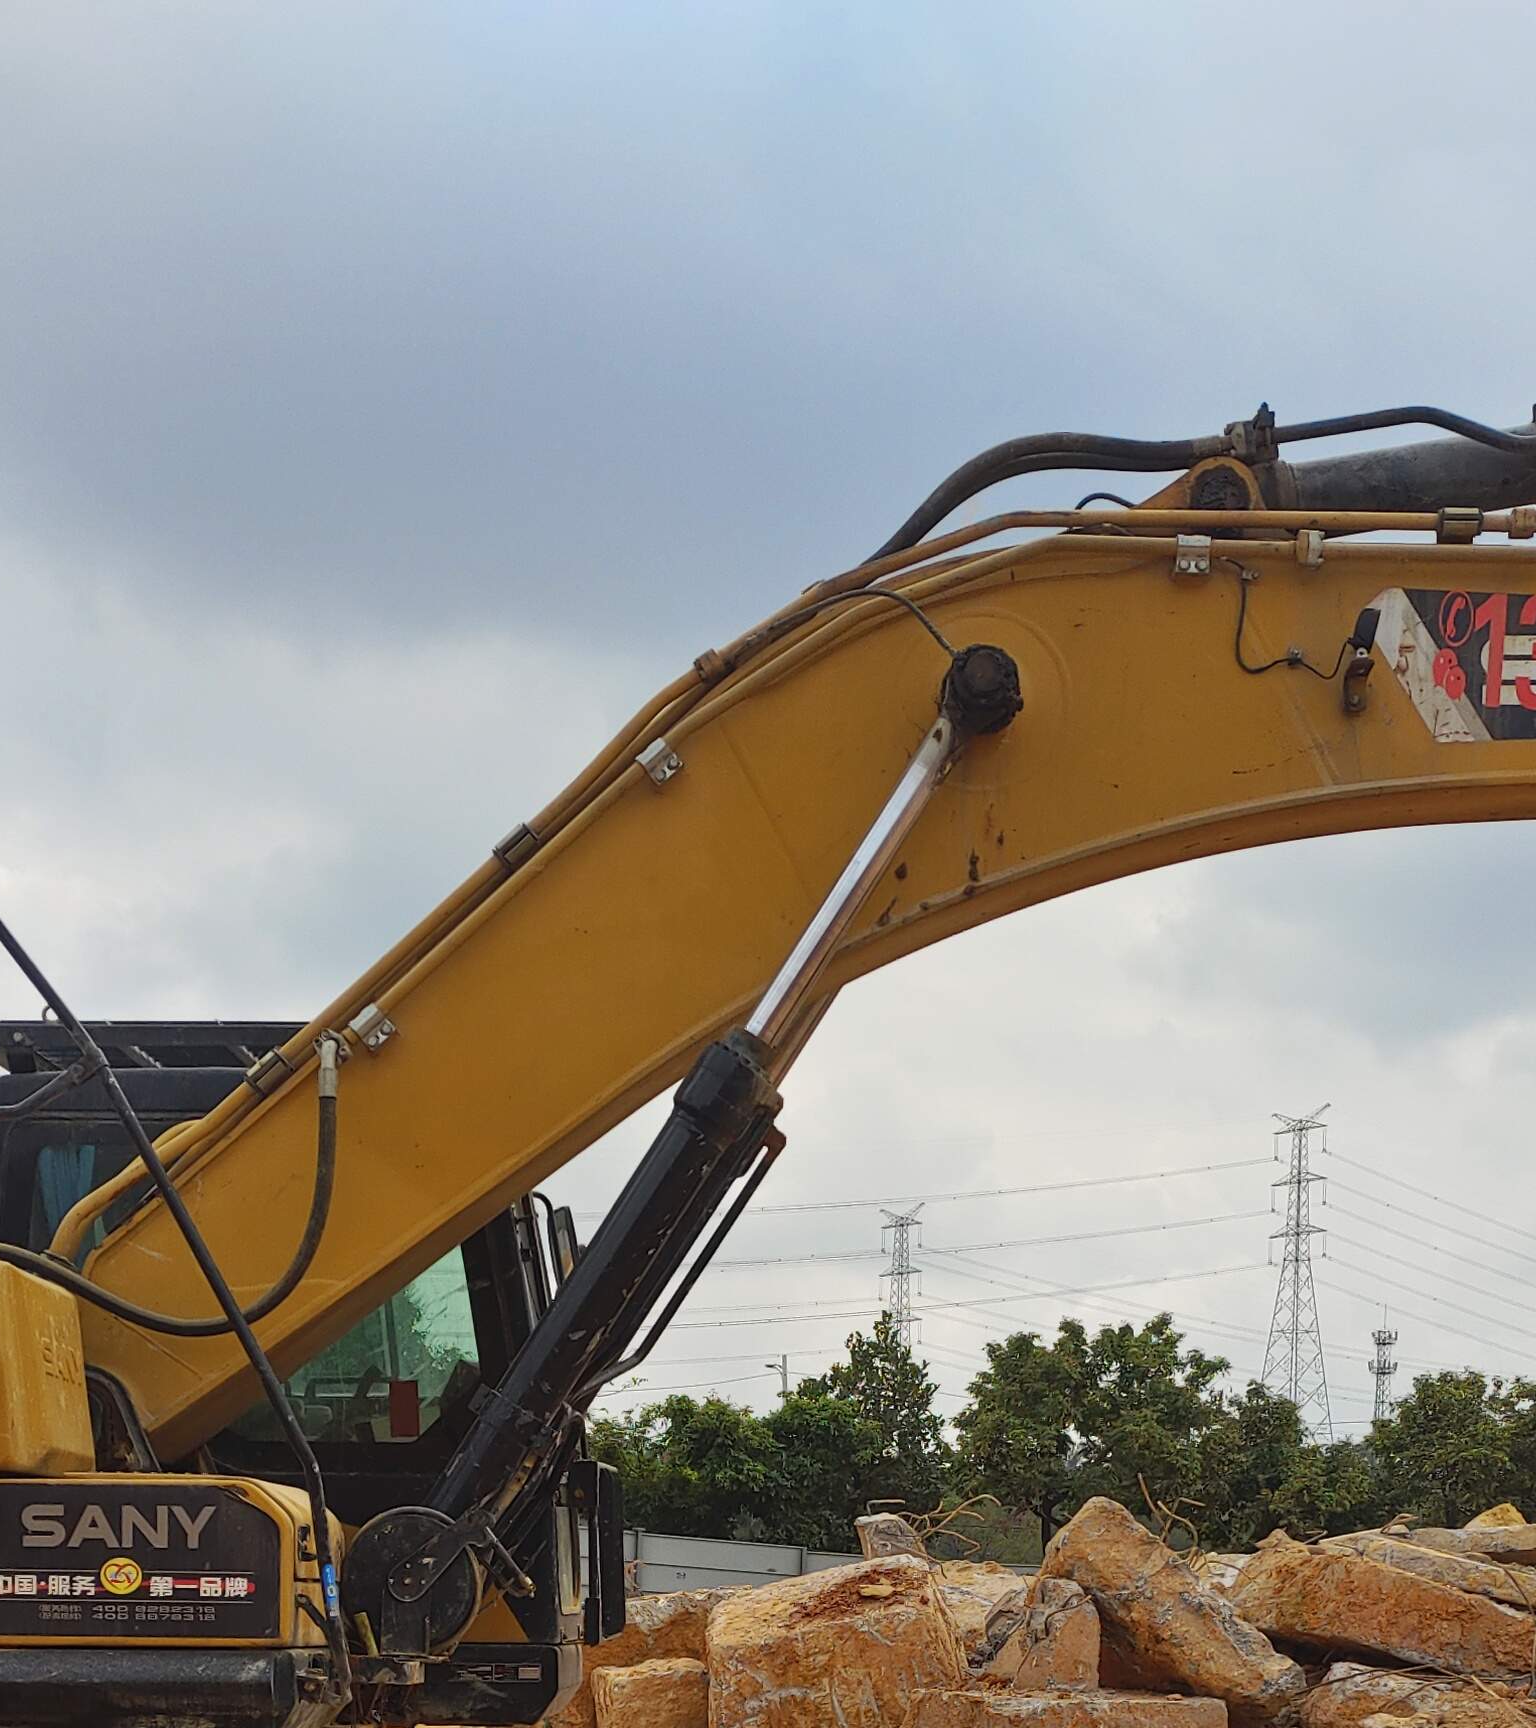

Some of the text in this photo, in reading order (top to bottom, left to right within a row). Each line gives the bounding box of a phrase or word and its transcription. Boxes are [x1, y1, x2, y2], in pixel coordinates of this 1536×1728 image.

[20, 1503, 217, 1550] SANY
[148, 1575, 249, 1598] 第一品牌
